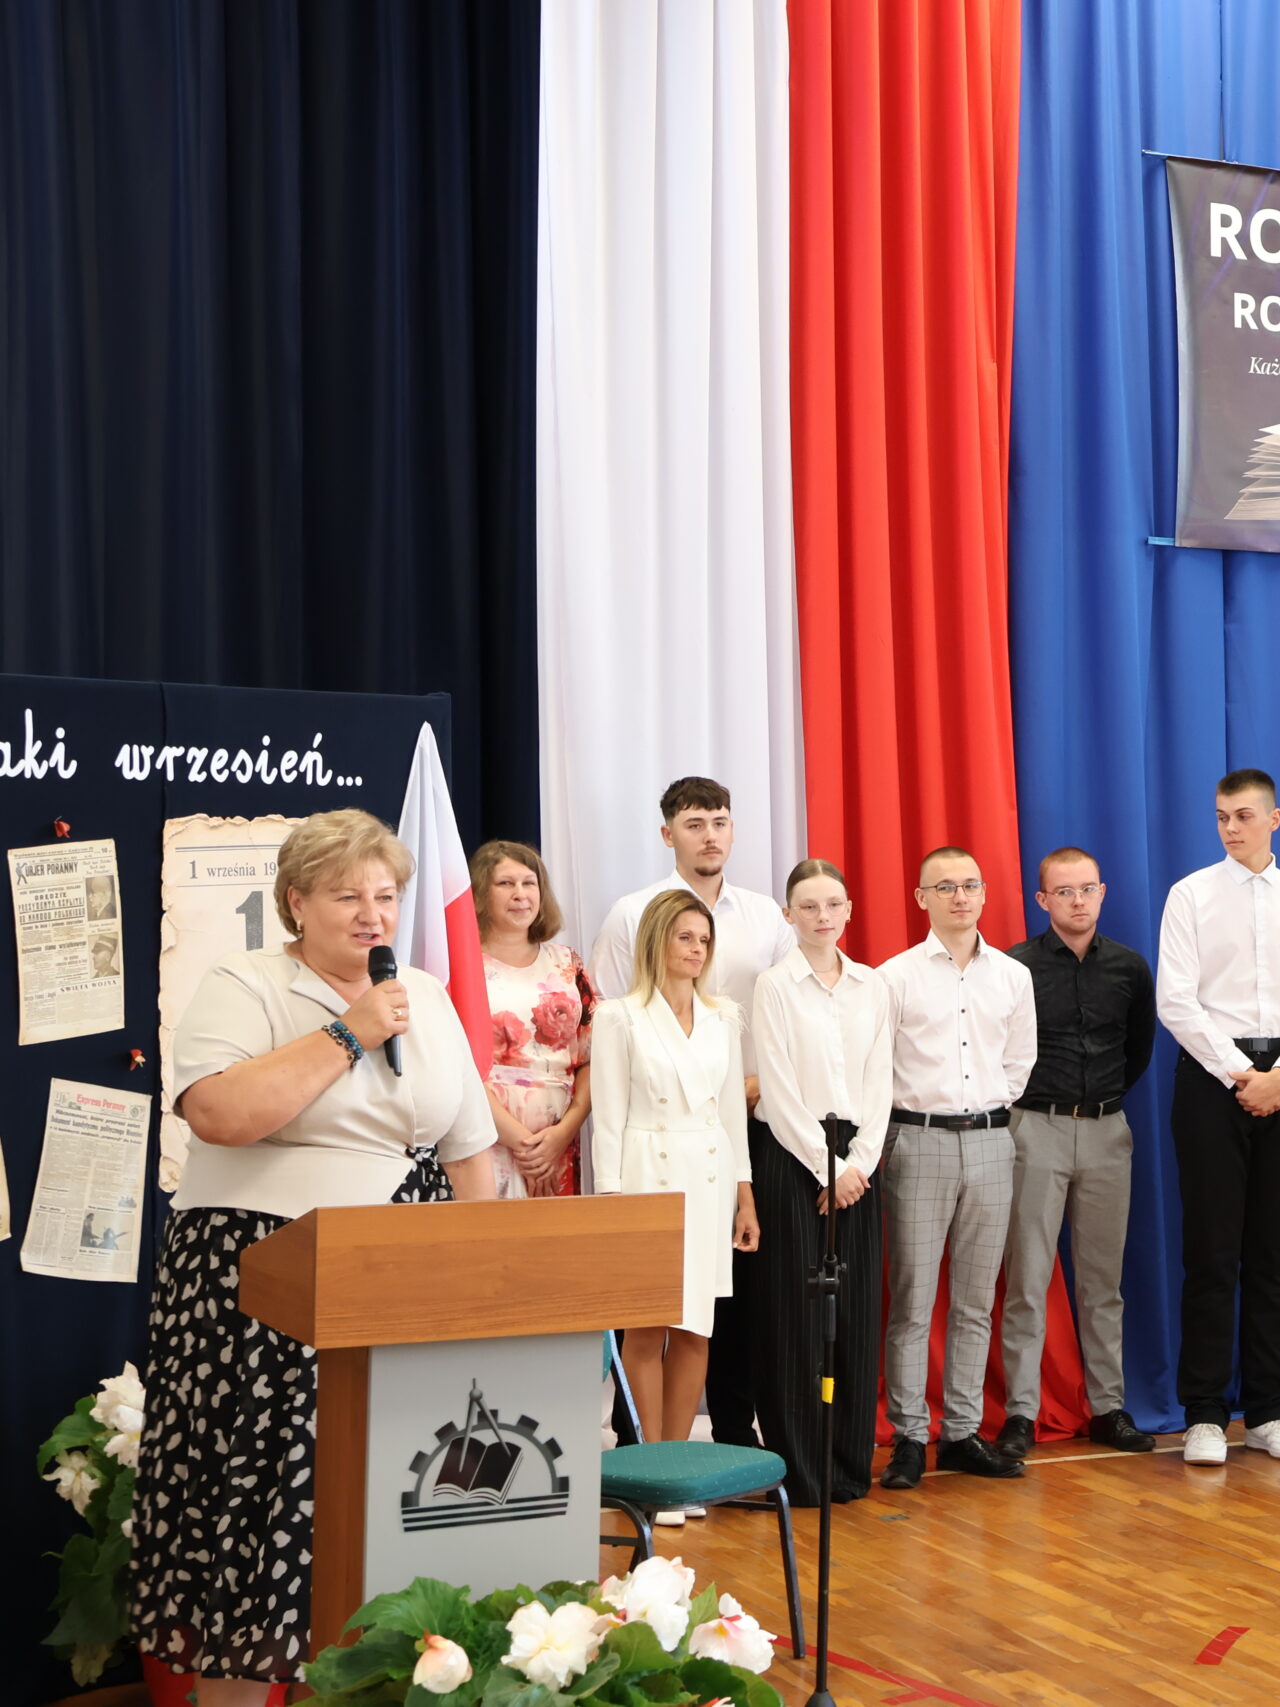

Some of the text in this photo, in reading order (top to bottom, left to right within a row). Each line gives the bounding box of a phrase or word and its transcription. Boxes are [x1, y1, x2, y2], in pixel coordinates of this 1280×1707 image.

[114, 732, 363, 786] wrzesień...
[189, 860, 198, 879] 1
[206, 862, 256, 878] września
[235, 890, 264, 951] 1
